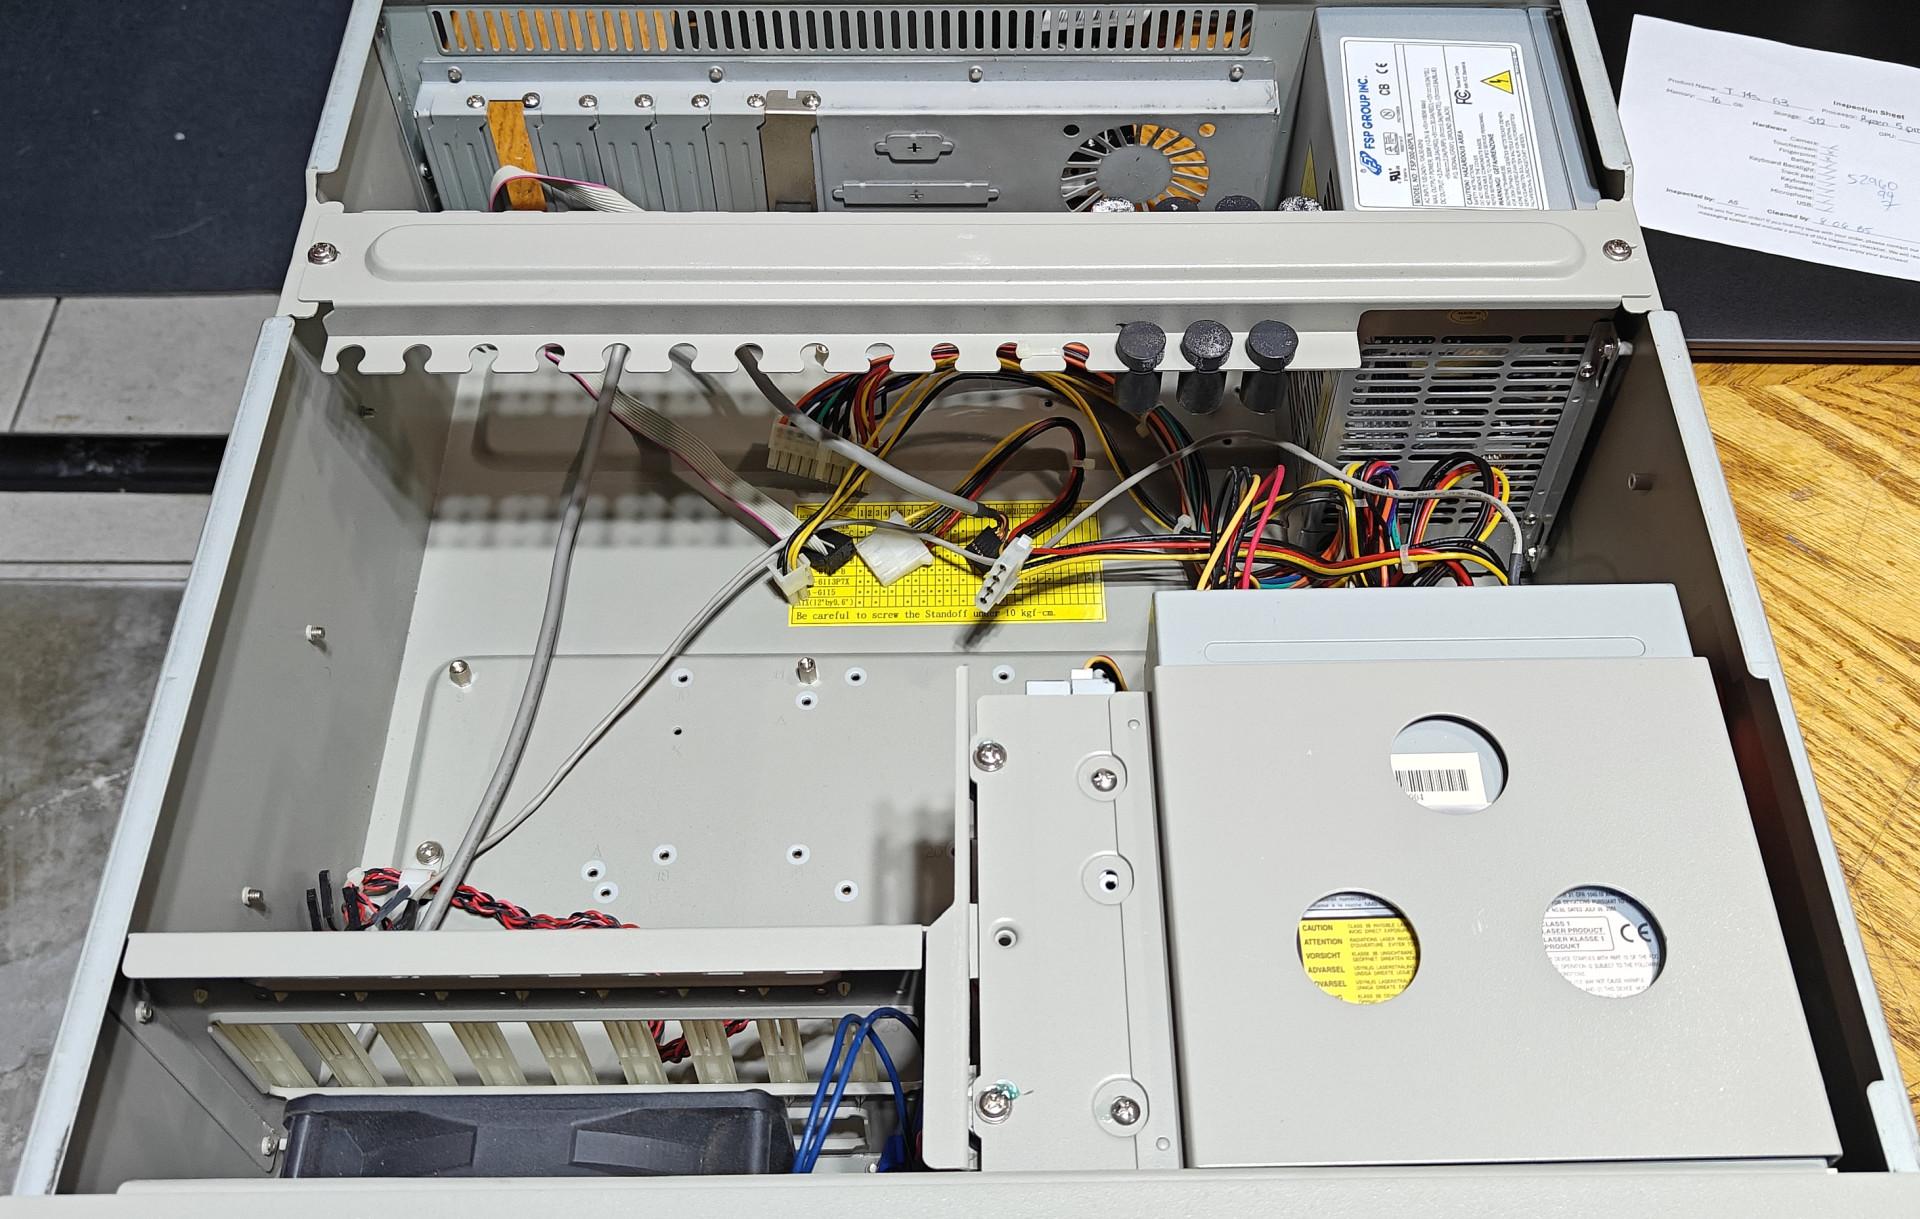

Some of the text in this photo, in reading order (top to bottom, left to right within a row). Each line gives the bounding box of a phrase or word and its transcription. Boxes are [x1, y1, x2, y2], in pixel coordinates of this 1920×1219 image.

[1376, 62, 1389, 73] CE
[1668, 78, 1694, 87] Product
[1379, 83, 1391, 95] CB
[1358, 75, 1375, 149] FSP GROUP INC.
[1834, 100, 1904, 120] Inspection Sheet
[1752, 121, 1787, 132] Hardware
[1808, 116, 1825, 125] 512
[1488, 133, 1499, 174] GEFAHRENZONE
[1460, 145, 1469, 177] HAZARDOUS
[1413, 184, 1421, 203] MODEL
[1464, 179, 1473, 204] CAUTION!
[1666, 188, 1703, 200] Inspected
[1767, 208, 1798, 219] Cleaned
[796, 612, 808, 620] Be
[813, 611, 849, 620] careful
[857, 612, 867, 620] to
[905, 610, 920, 619] the
[925, 608, 967, 619] Standoff
[1005, 609, 1016, 617] 10
[1021, 608, 1056, 617] kgf-cm.
[1620, 923, 1652, 942] CE
[1304, 938, 1343, 946] ATTENTION
